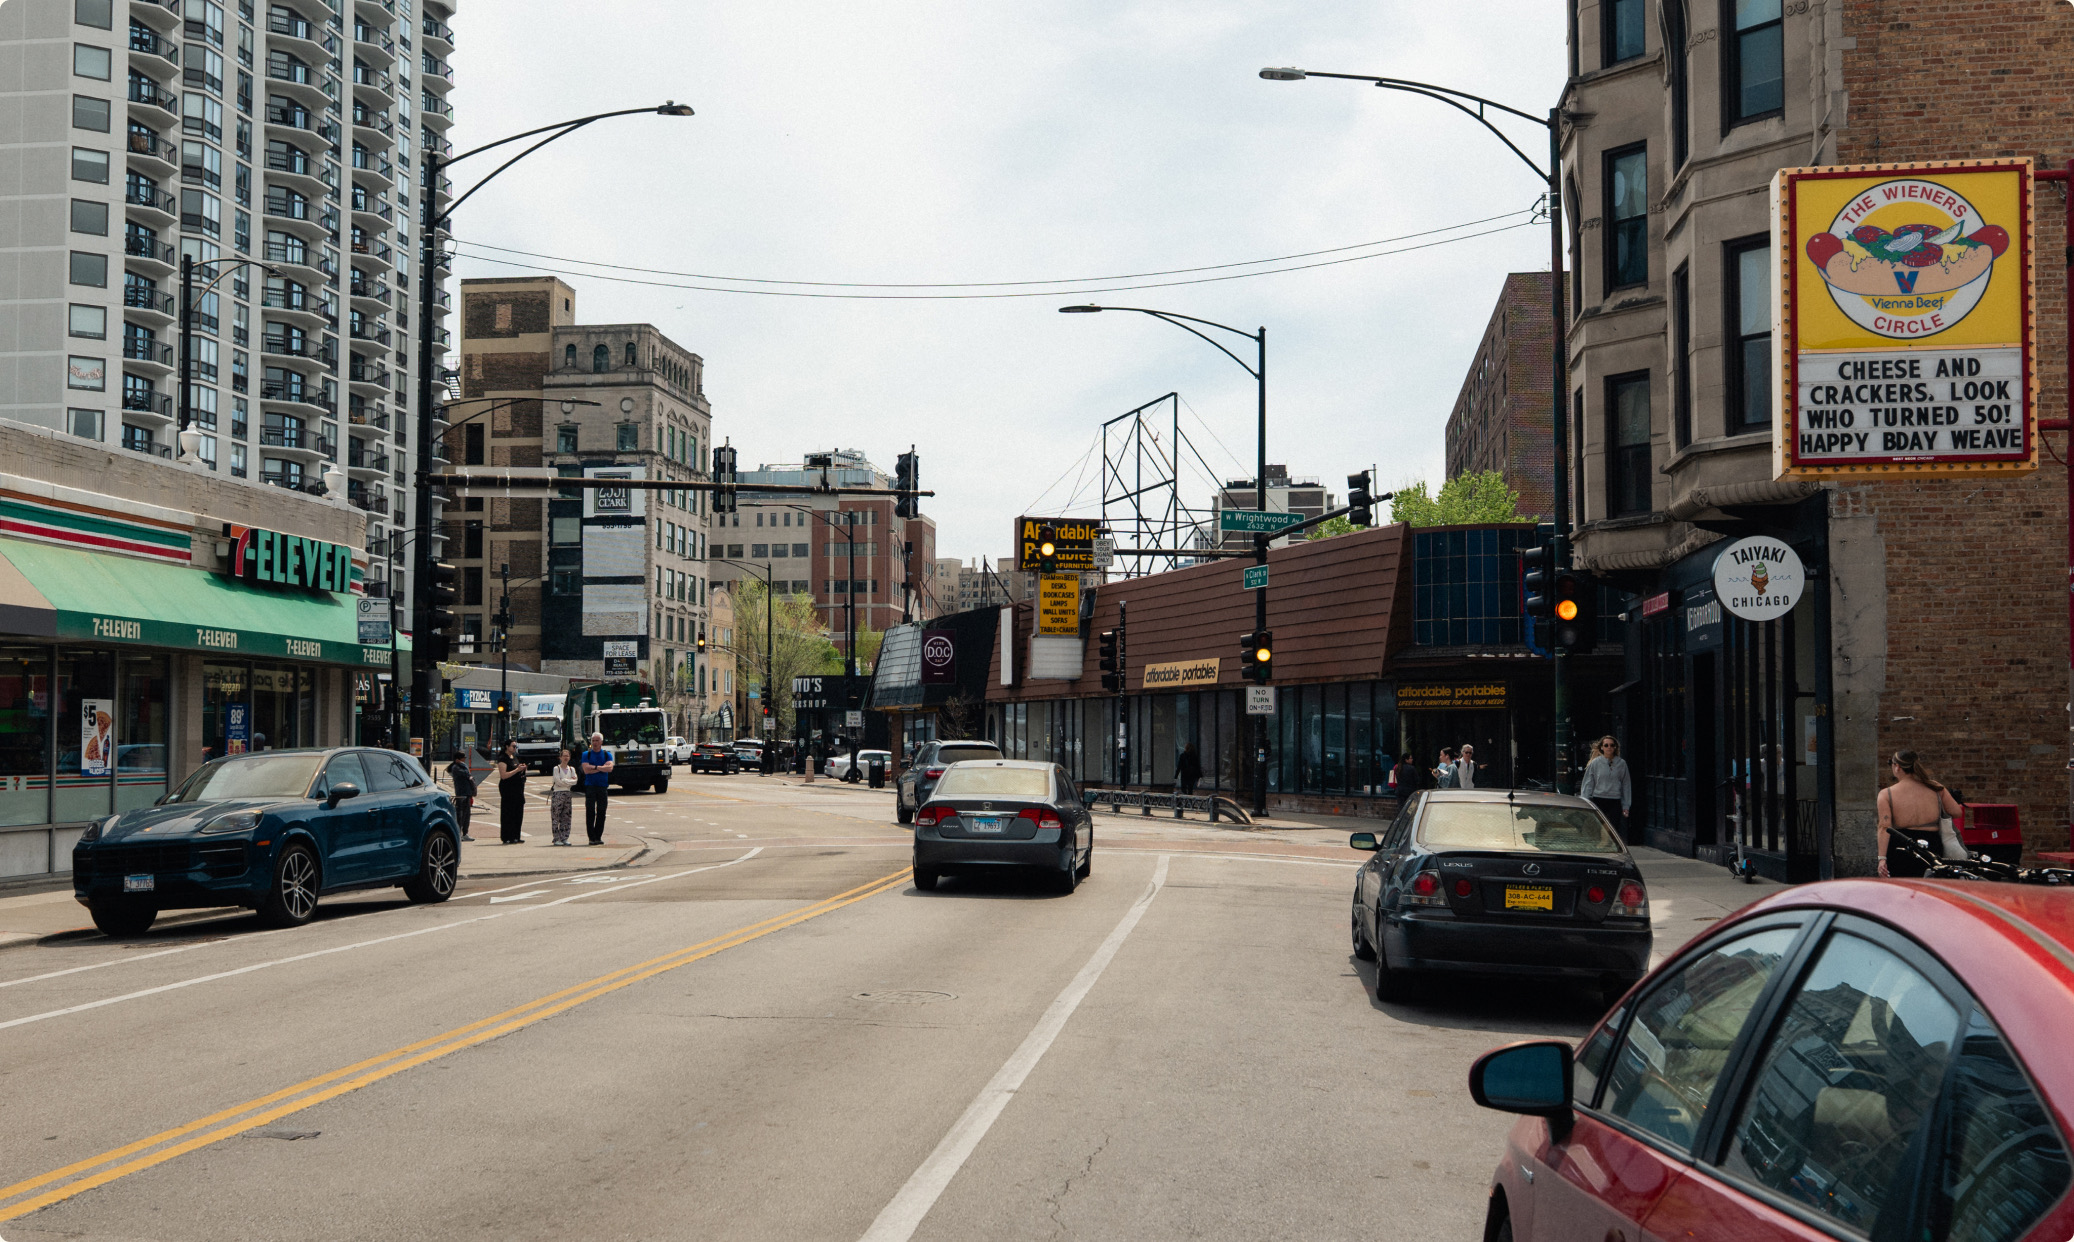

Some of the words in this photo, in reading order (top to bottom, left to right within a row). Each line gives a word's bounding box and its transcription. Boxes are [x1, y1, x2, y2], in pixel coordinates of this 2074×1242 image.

[1841, 195, 1876, 224] THE
[1882, 185, 1967, 218] WIENERS
[1872, 298, 1914, 309] Vienna
[1916, 296, 1944, 311] Beef
[1874, 313, 1944, 333] CIRCLE
[1838, 359, 1921, 381] CHEESE
[1936, 358, 1981, 378] AND
[1951, 380, 2011, 401] LOOK
[1806, 408, 1855, 429] WHO
[1869, 406, 1959, 427] TURNED
[1974, 404, 2011, 425] 50!
[1800, 432, 1869, 453] HAPPY
[1882, 431, 1938, 451] BDAY
[1951, 428, 2022, 450] WEAVE
[598, 498, 627, 508] CLARK
[1235, 512, 1289, 524] Wrightwood
[1023, 521, 1099, 541] Afrdable
[1730, 545, 1787, 565] TAIYAKI
[1249, 570, 1262, 579] Clark
[1043, 591, 1075, 599] BOOKCASES
[1732, 595, 1790, 608] CHICAGO
[1058, 608, 1076, 616] UNITS
[1687, 599, 1720, 633] NEIGHBORHOOD
[1145, 666, 1180, 684] affordable
[1181, 662, 1217, 684] portables
[469, 690, 492, 702] FYZICAL
[1397, 685, 1452, 697] affordable
[1455, 684, 1506, 698] portables
[83, 705, 97, 726] $5
